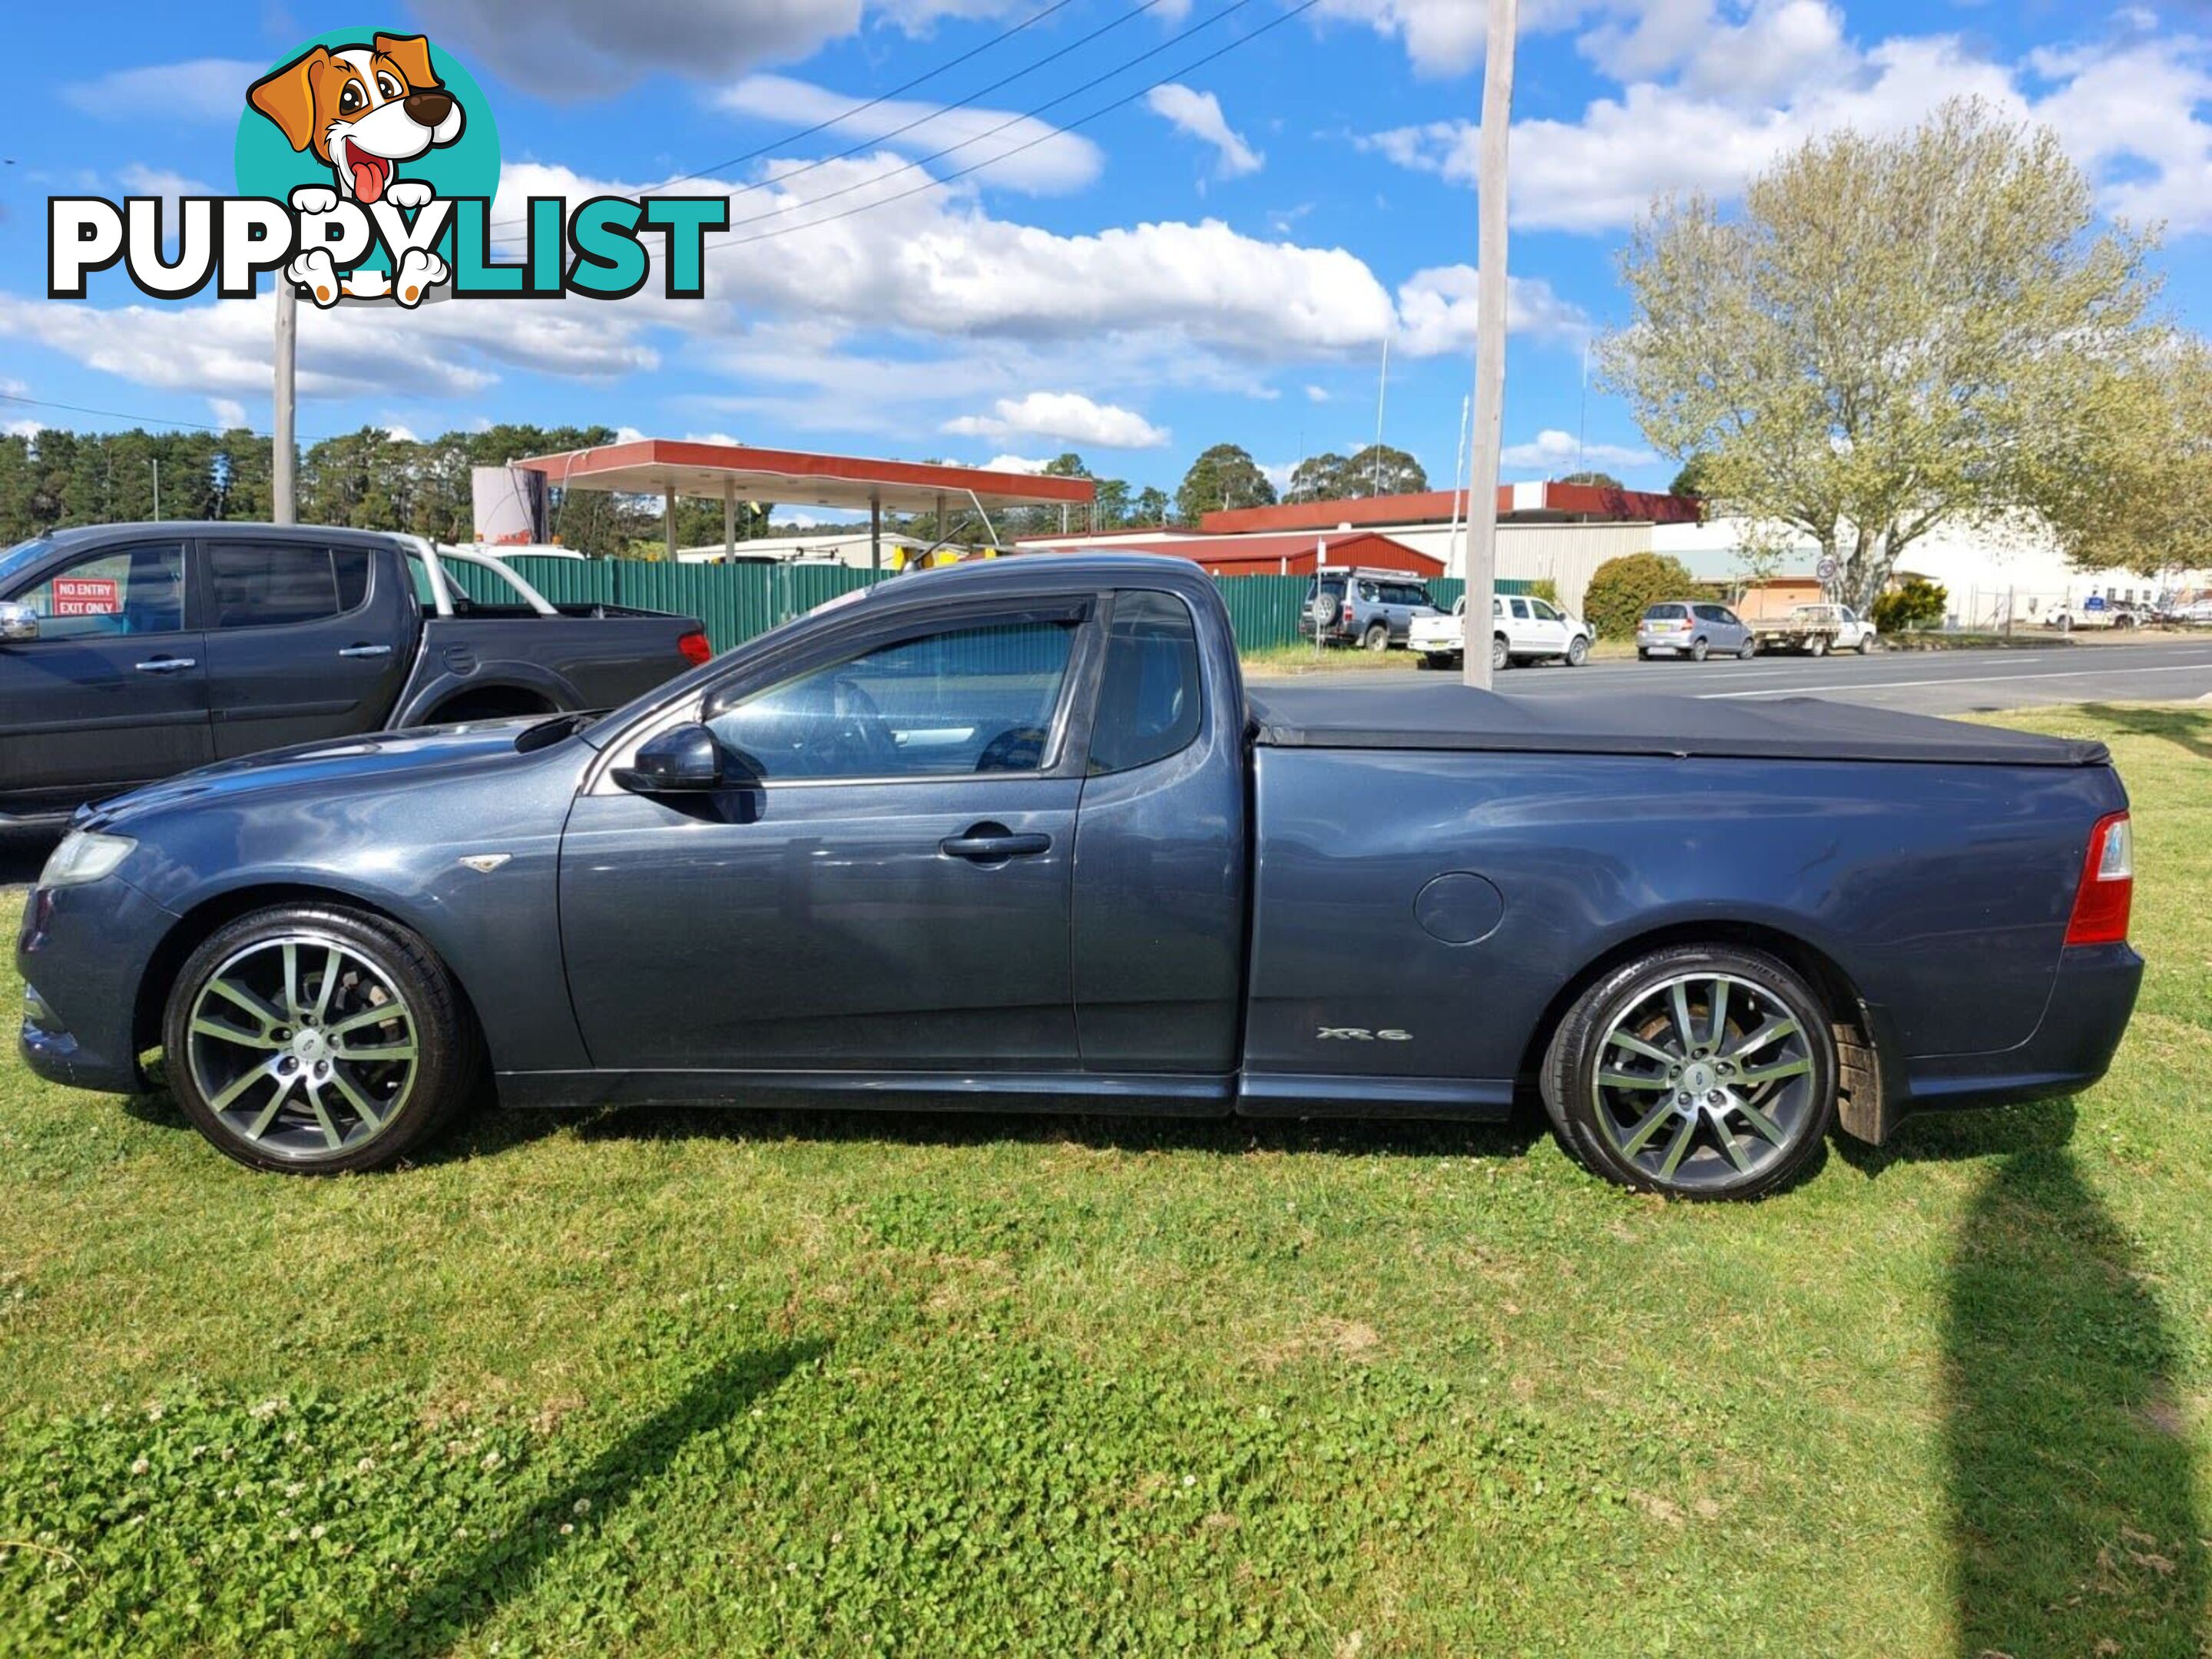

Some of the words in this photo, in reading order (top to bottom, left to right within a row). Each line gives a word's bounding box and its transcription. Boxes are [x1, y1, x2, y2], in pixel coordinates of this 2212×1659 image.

[59, 584, 75, 595] NO
[77, 584, 111, 596] ENTRY
[60, 602, 84, 614] EXIT
[86, 602, 113, 614] ONLY
[1316, 1027, 1414, 1041] XR6
